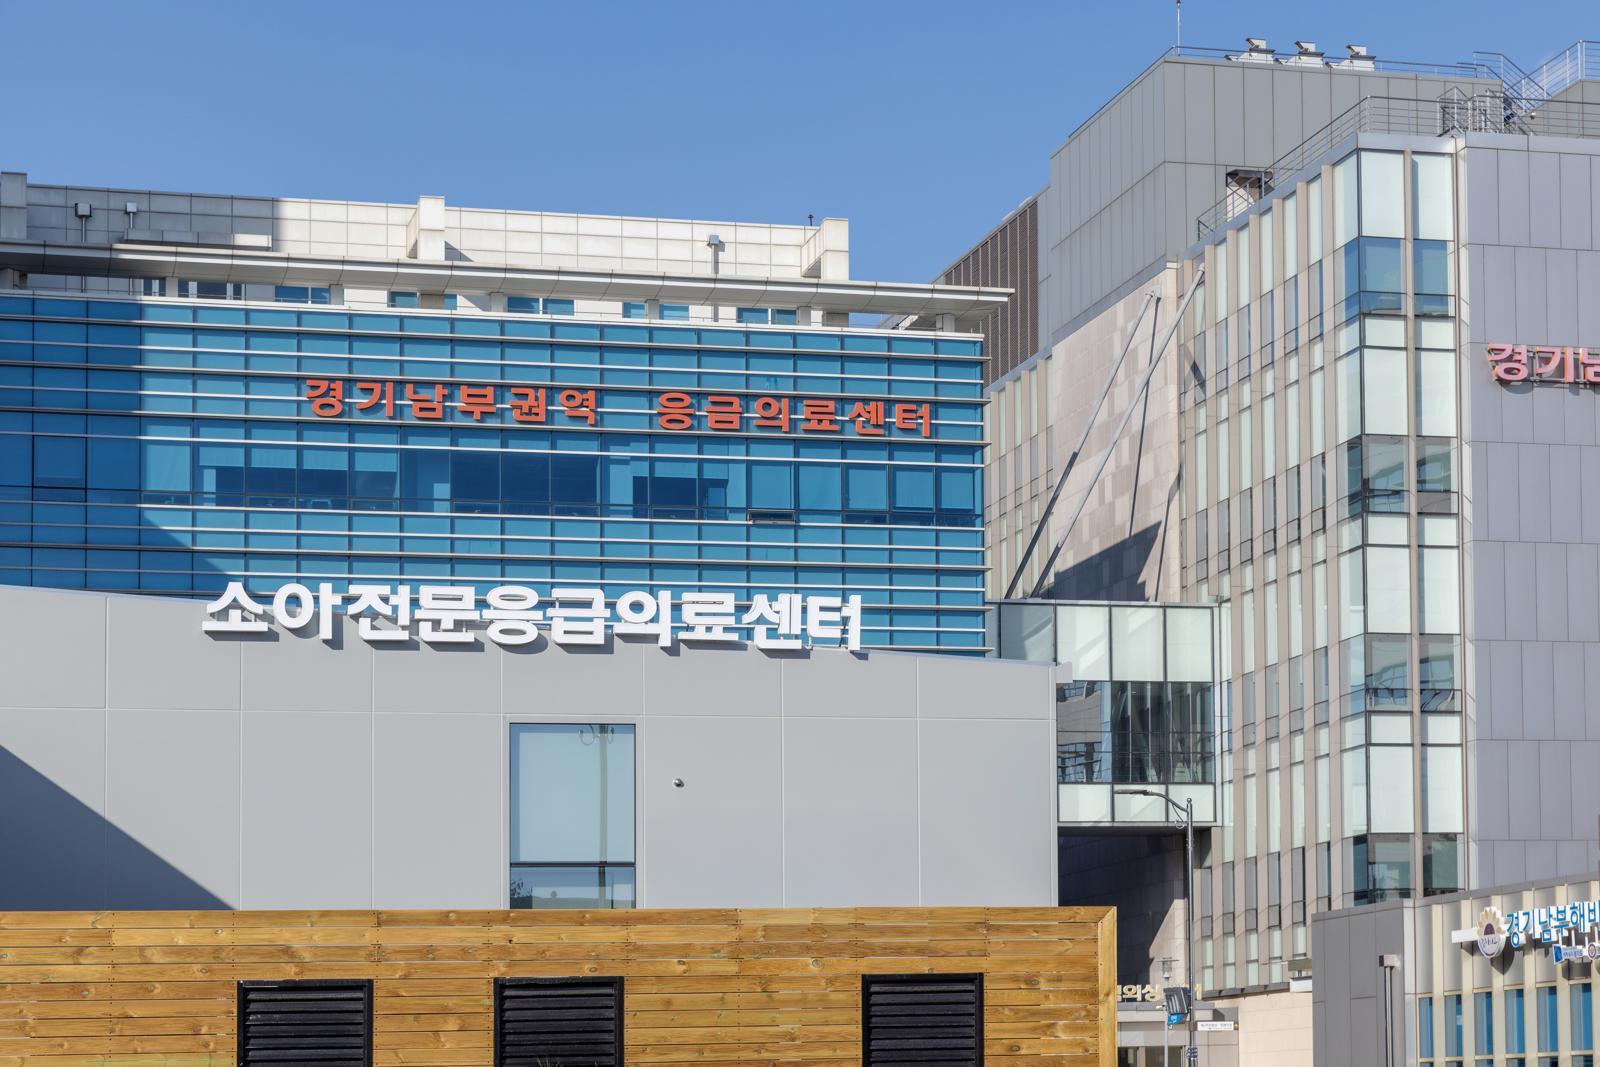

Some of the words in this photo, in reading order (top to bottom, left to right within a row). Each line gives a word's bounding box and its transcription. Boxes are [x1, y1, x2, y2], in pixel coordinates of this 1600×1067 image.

[304, 379, 597, 425] 경기남부권역
[656, 392, 931, 438] 응급의료센터
[201, 581, 862, 651] 소아전문응급의료센터
